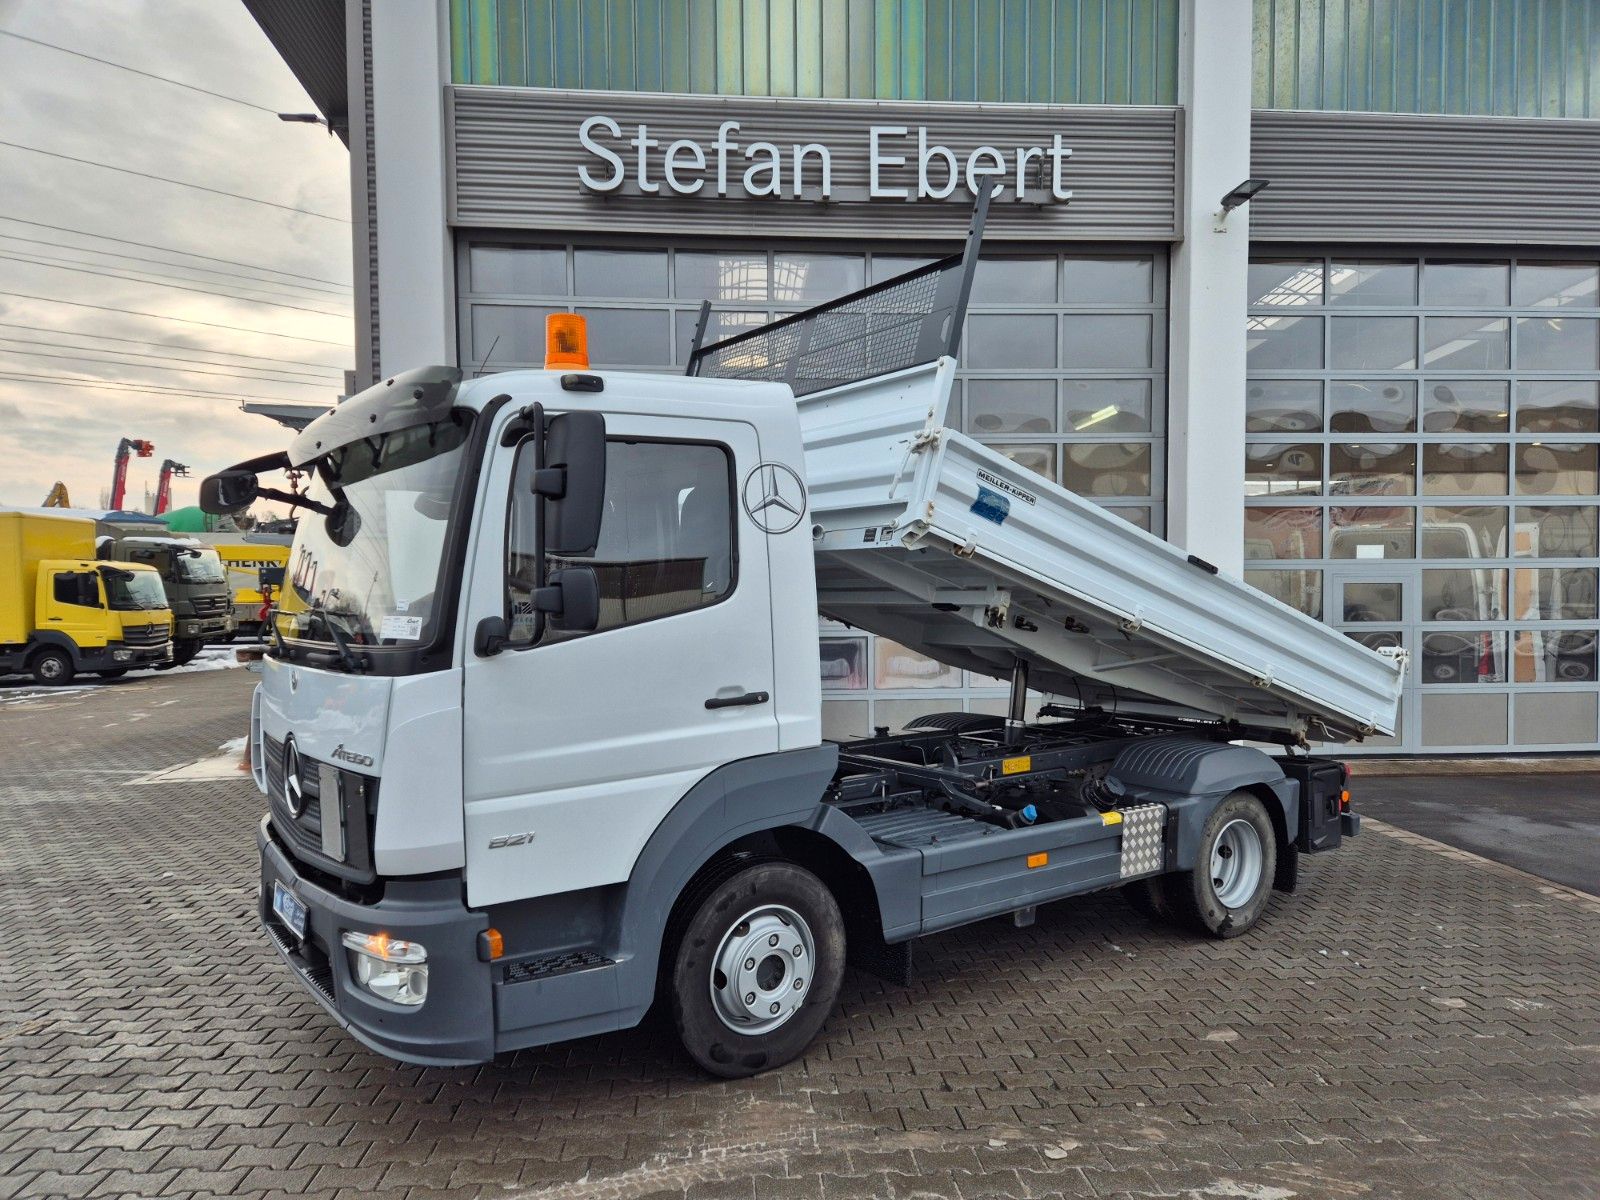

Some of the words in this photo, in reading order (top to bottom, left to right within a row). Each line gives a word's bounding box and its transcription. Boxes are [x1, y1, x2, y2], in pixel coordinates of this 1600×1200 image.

[577, 115, 831, 200] Stefan
[869, 126, 1073, 201] Ebert
[488, 832, 535, 850] 821
